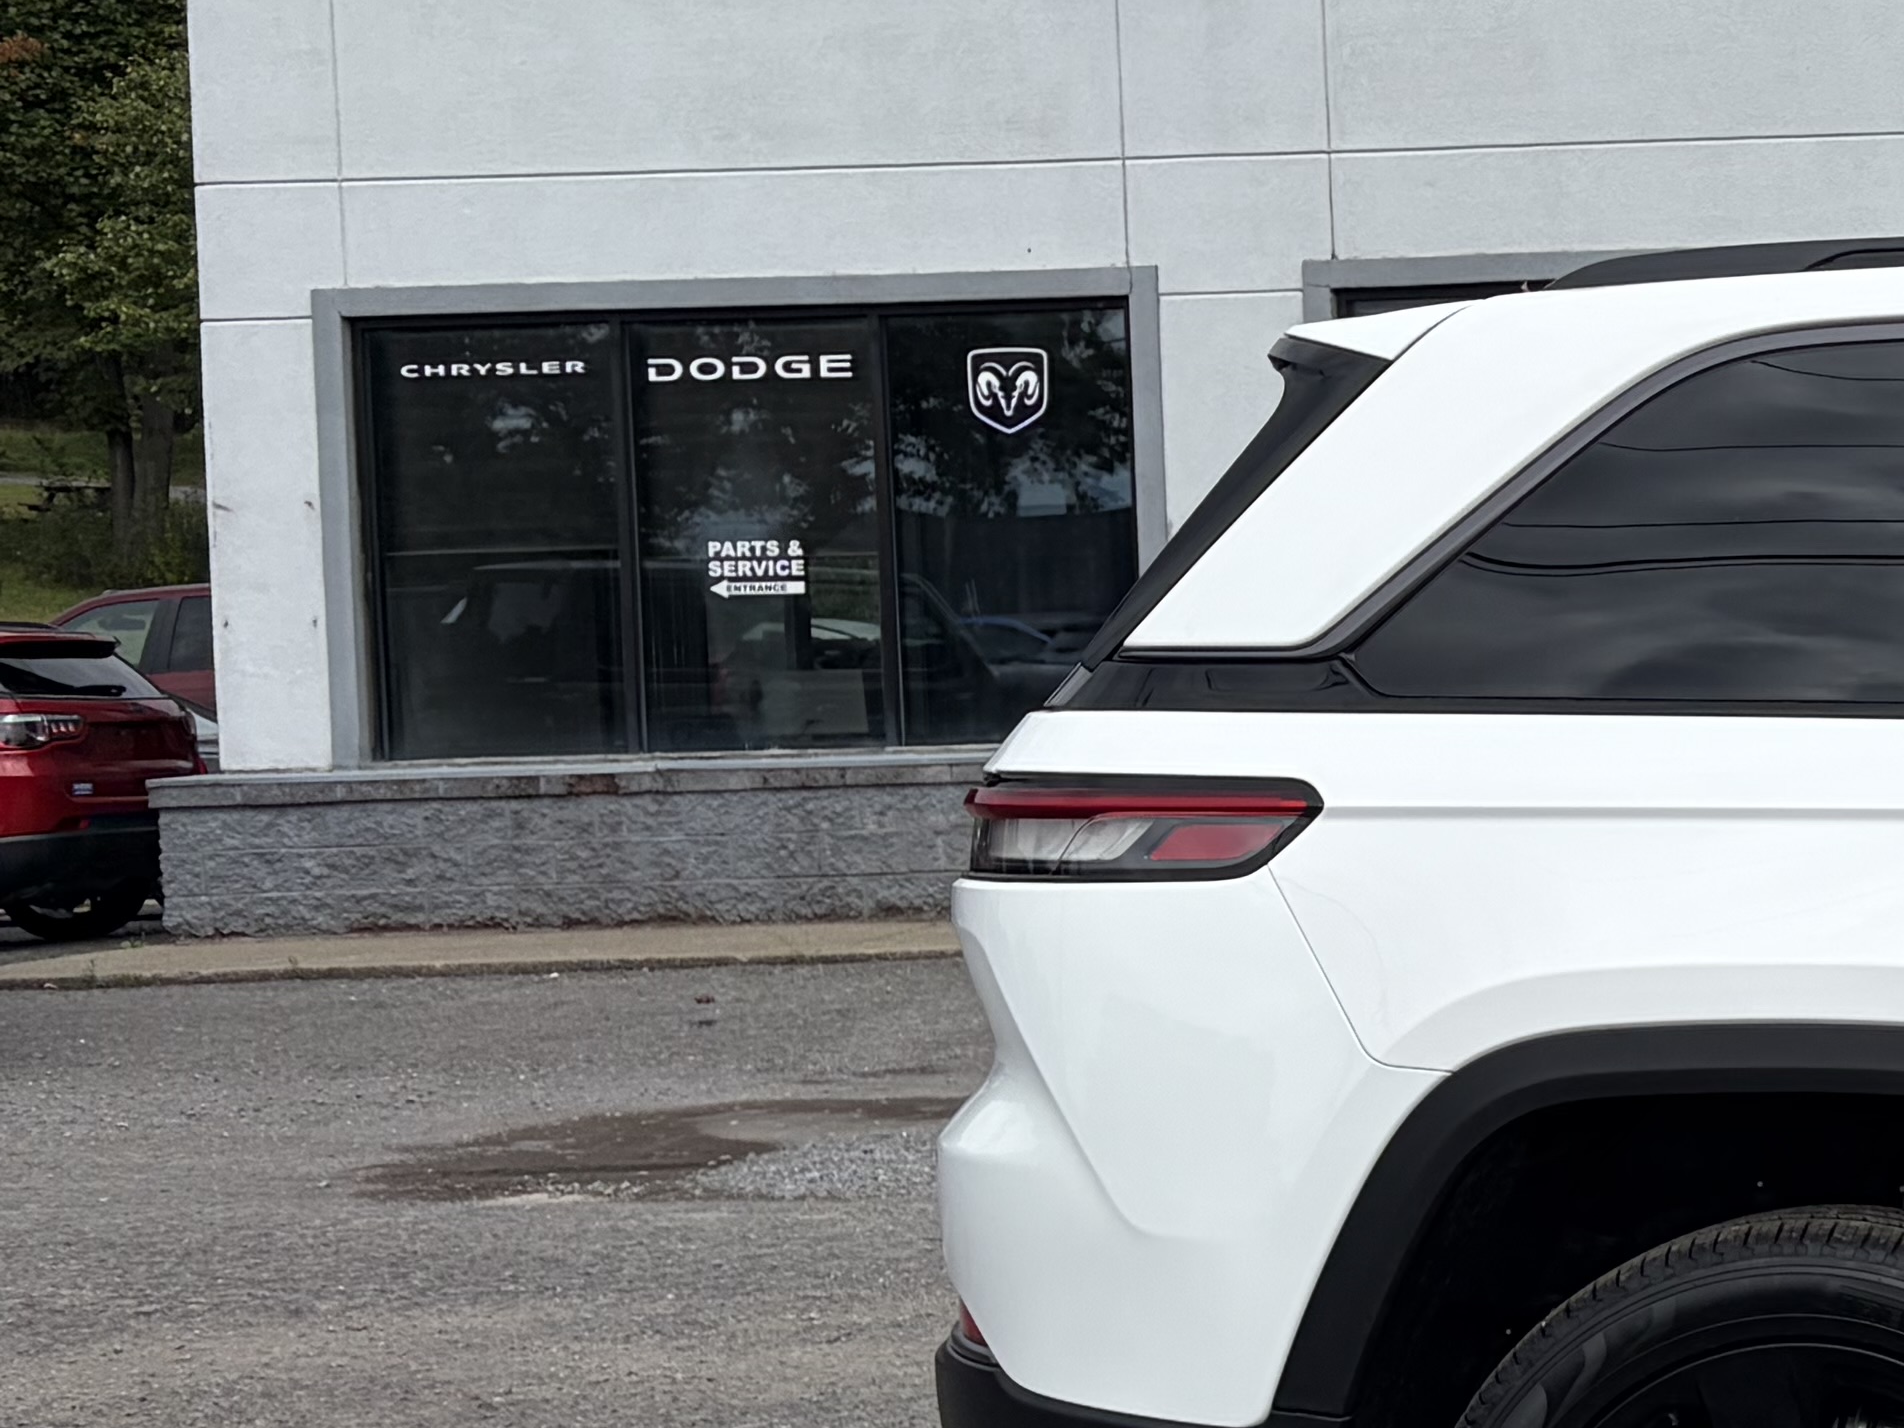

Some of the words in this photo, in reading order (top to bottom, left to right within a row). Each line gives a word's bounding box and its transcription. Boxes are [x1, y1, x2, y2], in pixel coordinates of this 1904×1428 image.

[400, 359, 586, 378] CHRYSLER
[647, 353, 854, 383] DODGE
[707, 540, 780, 558] PARTS
[787, 539, 804, 557] &
[708, 559, 805, 577] SERVICE
